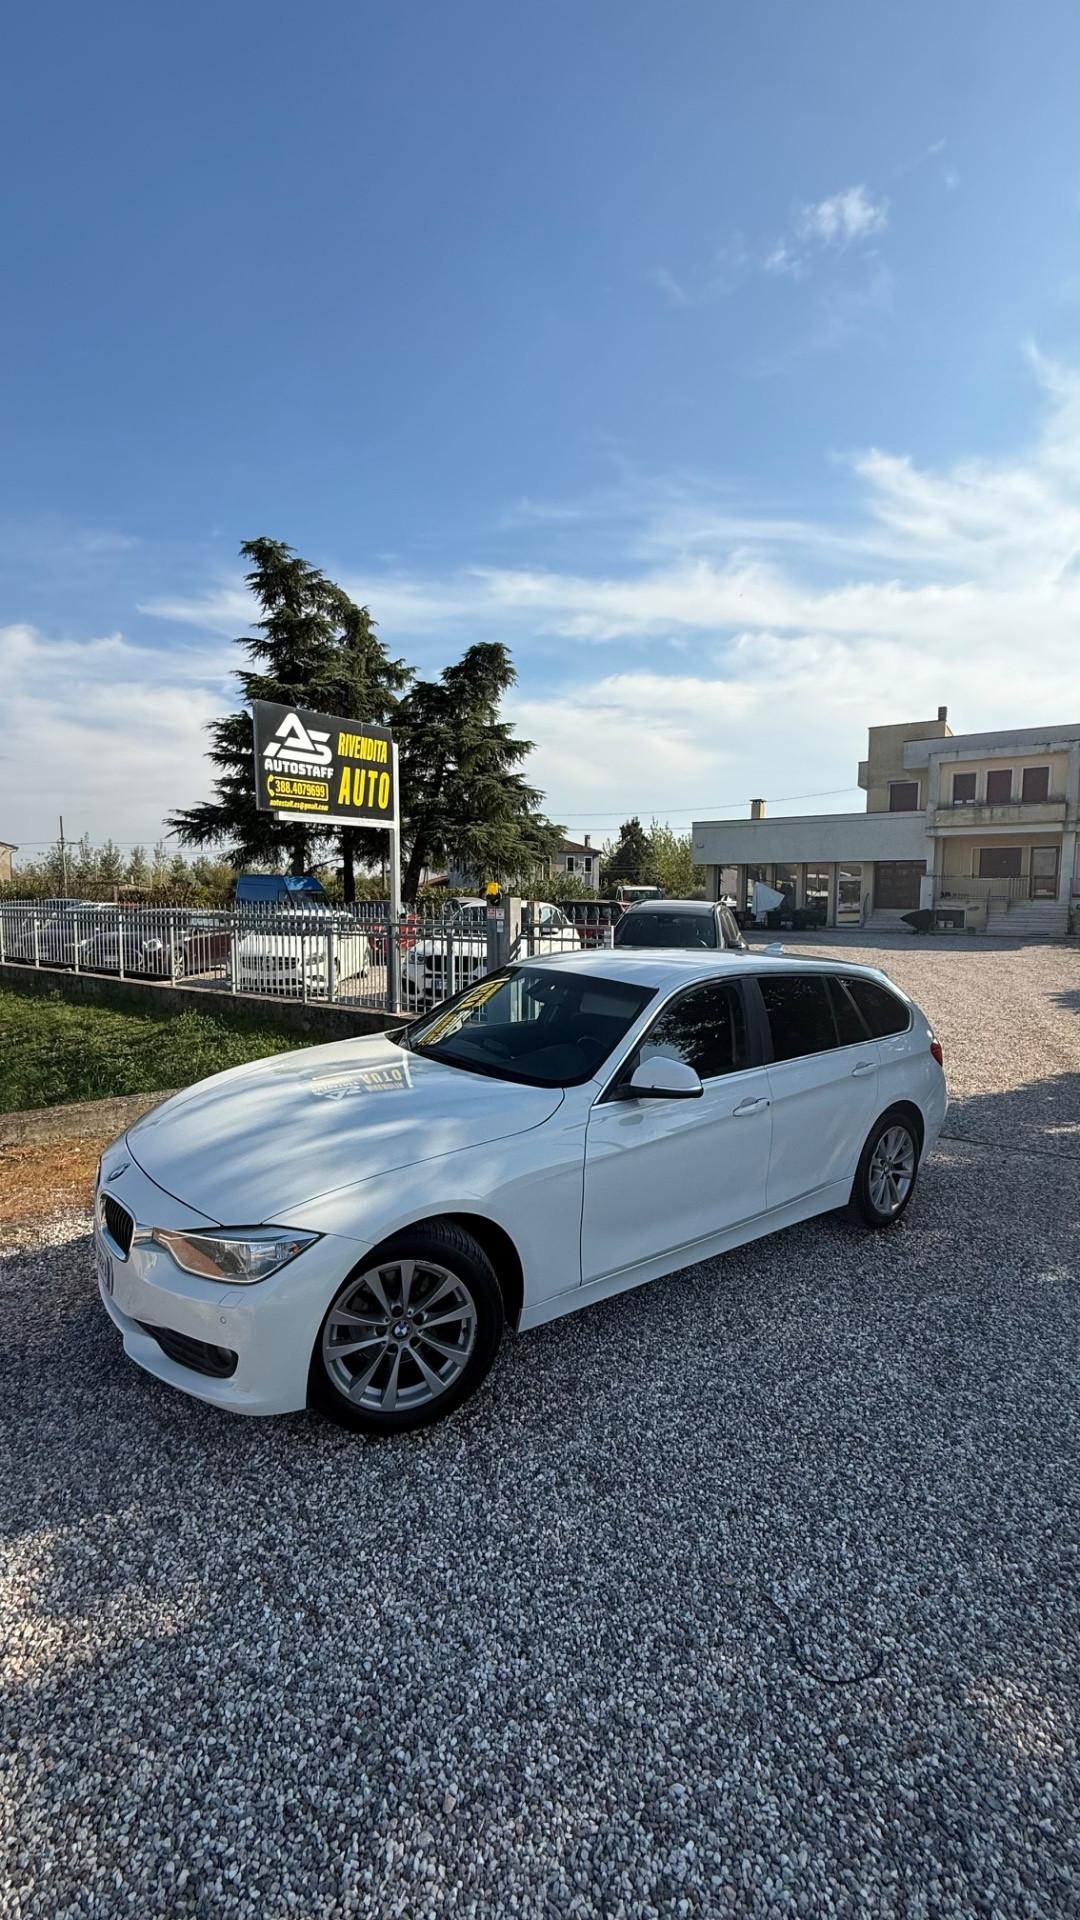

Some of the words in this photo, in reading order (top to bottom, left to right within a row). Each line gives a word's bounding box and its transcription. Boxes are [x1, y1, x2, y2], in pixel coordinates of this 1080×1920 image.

[263, 712, 332, 765] AS
[338, 732, 388, 763] RIVENDITA
[264, 758, 334, 779] AUTOSTAFF
[338, 766, 390, 809] AUTO
